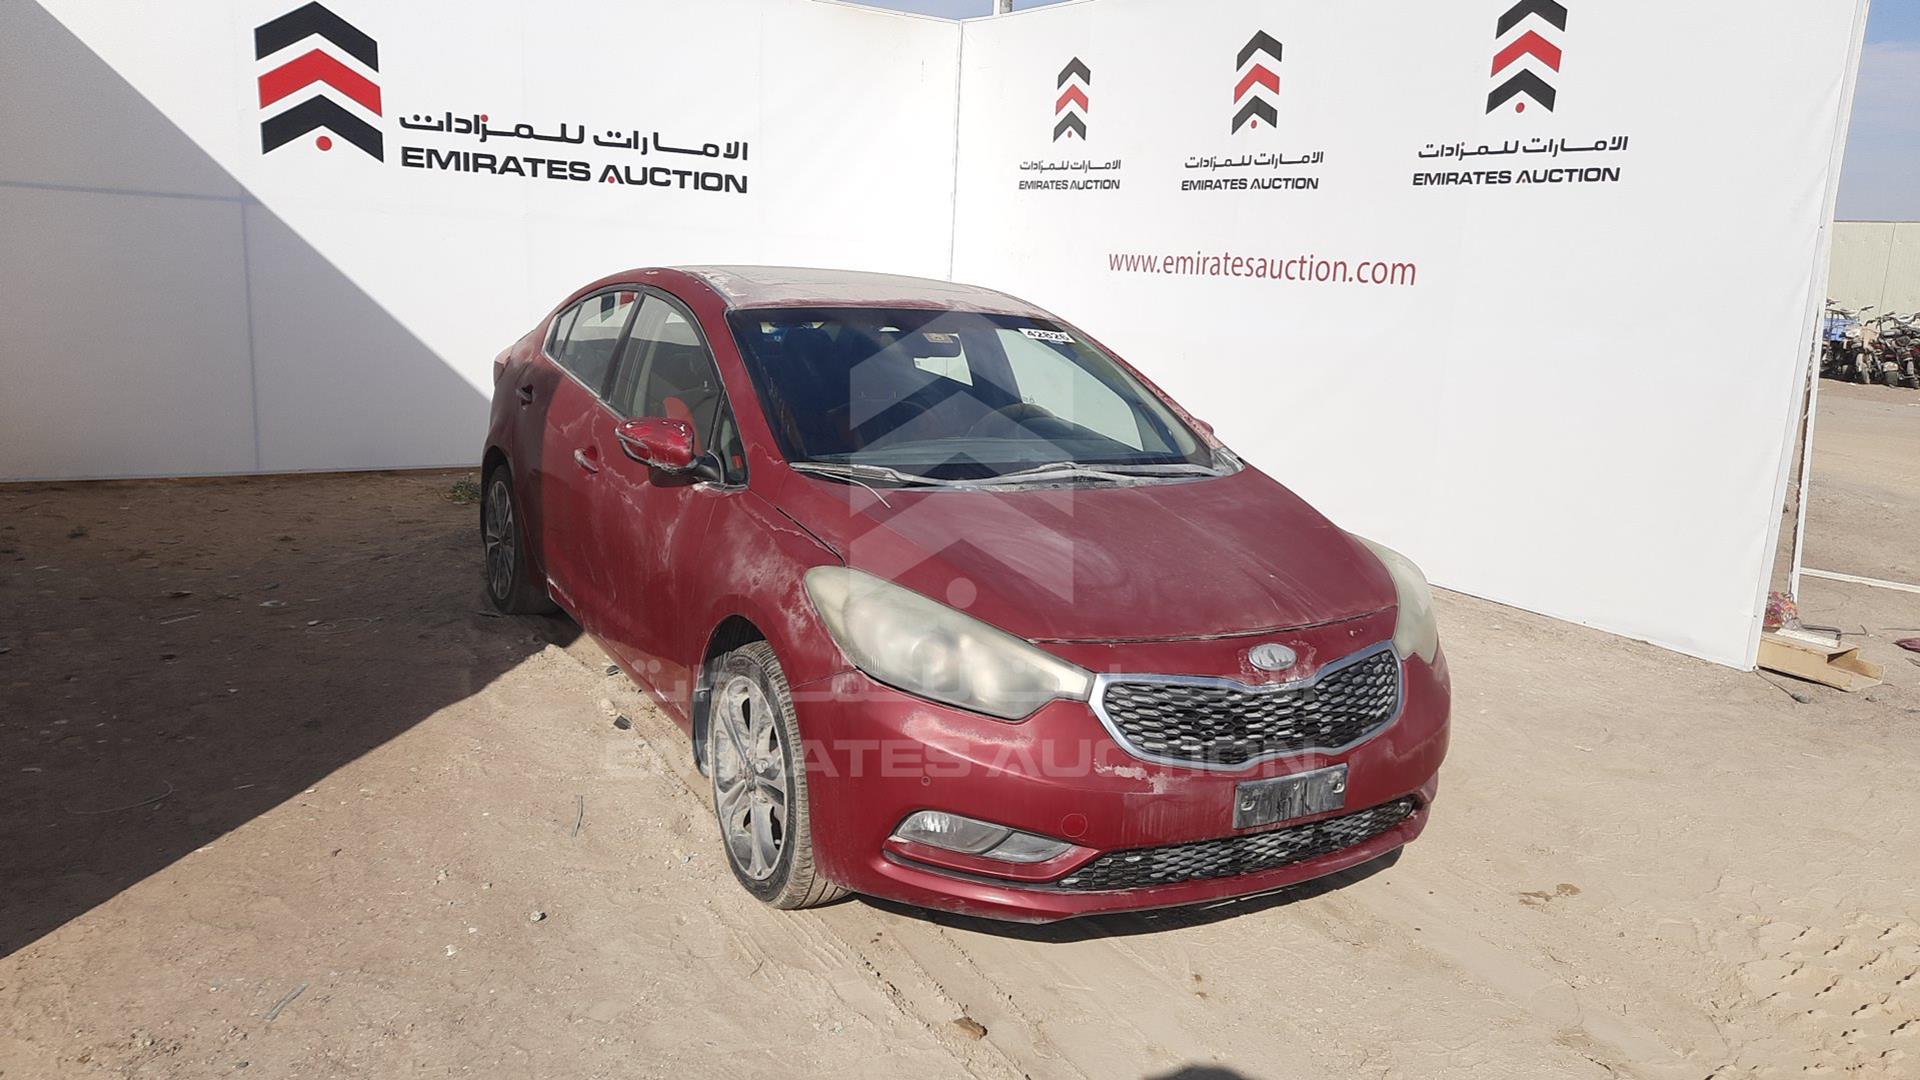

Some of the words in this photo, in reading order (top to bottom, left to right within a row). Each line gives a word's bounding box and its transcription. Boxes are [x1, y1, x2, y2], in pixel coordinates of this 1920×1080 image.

[399, 112, 584, 144] للمزادات
[401, 146, 592, 182] EMIRATES
[598, 165, 748, 194] AUCTION
[1412, 170, 1512, 186] EMIRATES
[1515, 167, 1620, 183] AUCTION
[1018, 179, 1069, 191] EMIRATES
[1069, 179, 1121, 190] AUCTION
[1181, 178, 1248, 191] EMIRATES
[1250, 178, 1319, 190] AUCTION
[1109, 251, 1416, 286] www.emiratesauction.com
